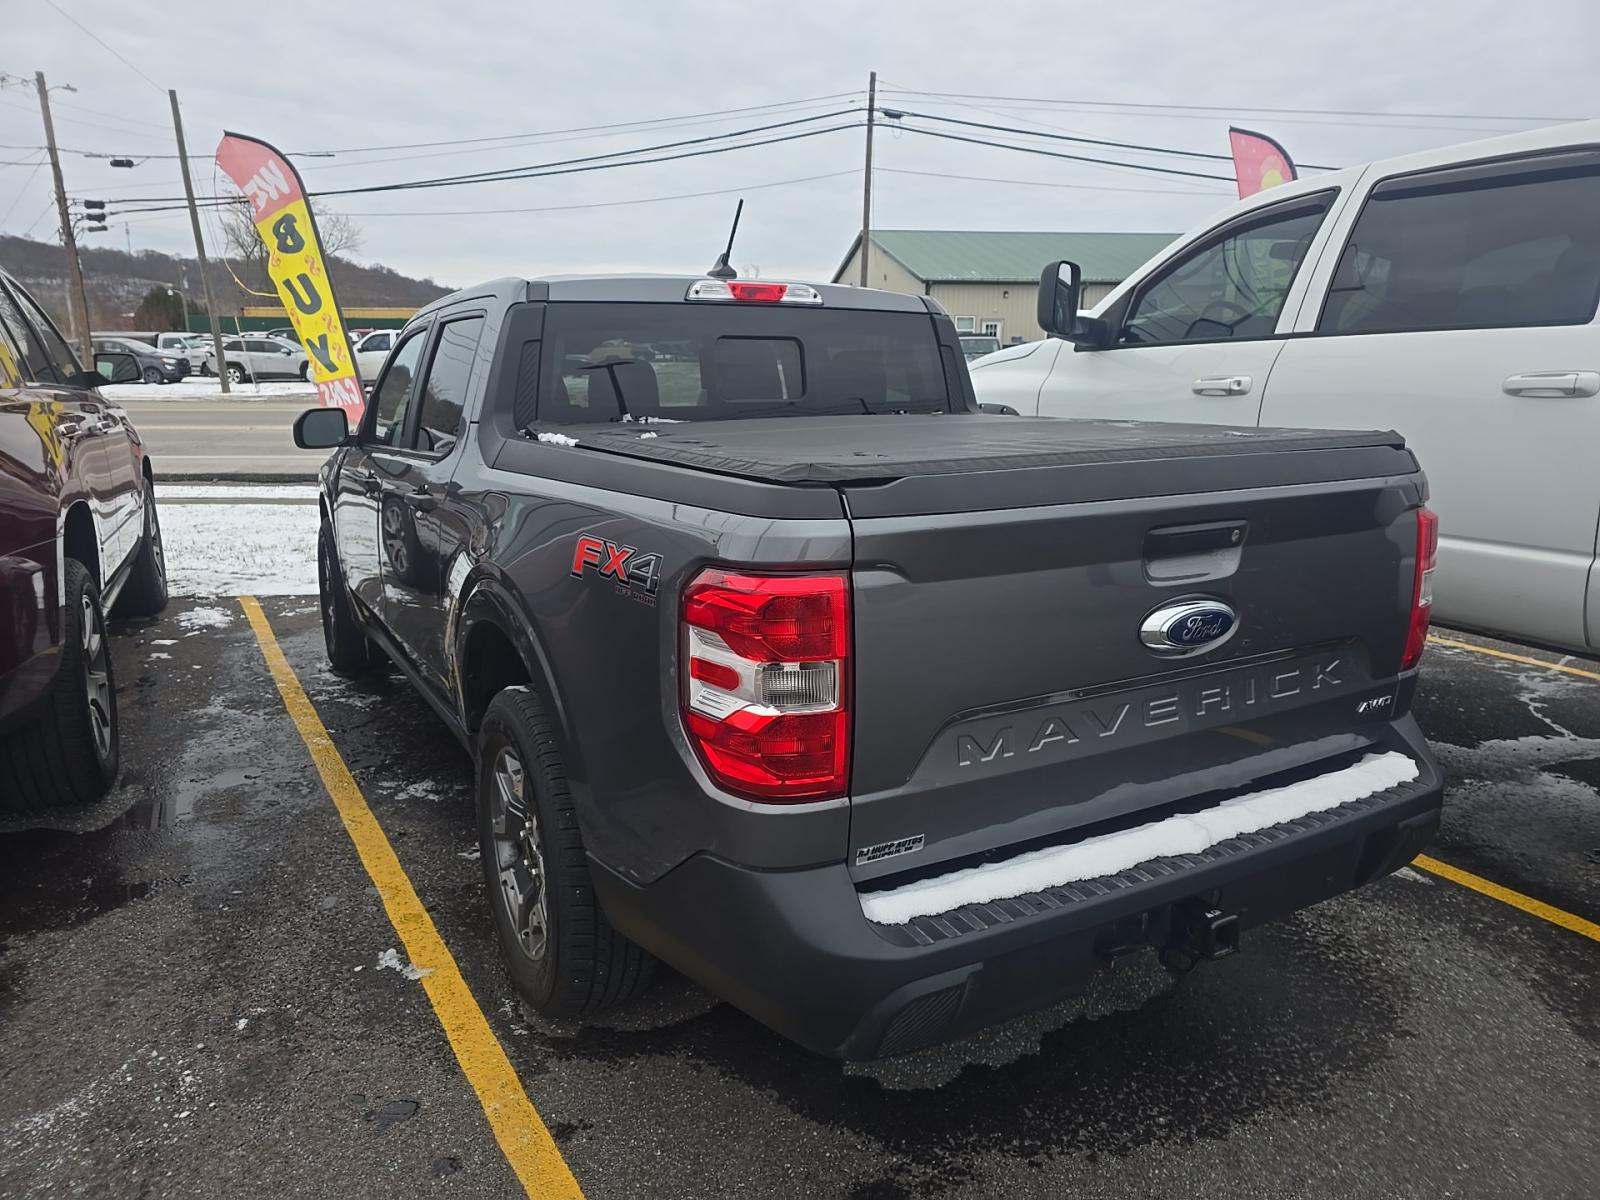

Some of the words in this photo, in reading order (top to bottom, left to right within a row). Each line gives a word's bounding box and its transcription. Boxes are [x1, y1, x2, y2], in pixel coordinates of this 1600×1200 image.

[570, 532, 664, 597] FX4
[1182, 614, 1223, 640] Ford
[957, 659, 1342, 766] MAVERICK
